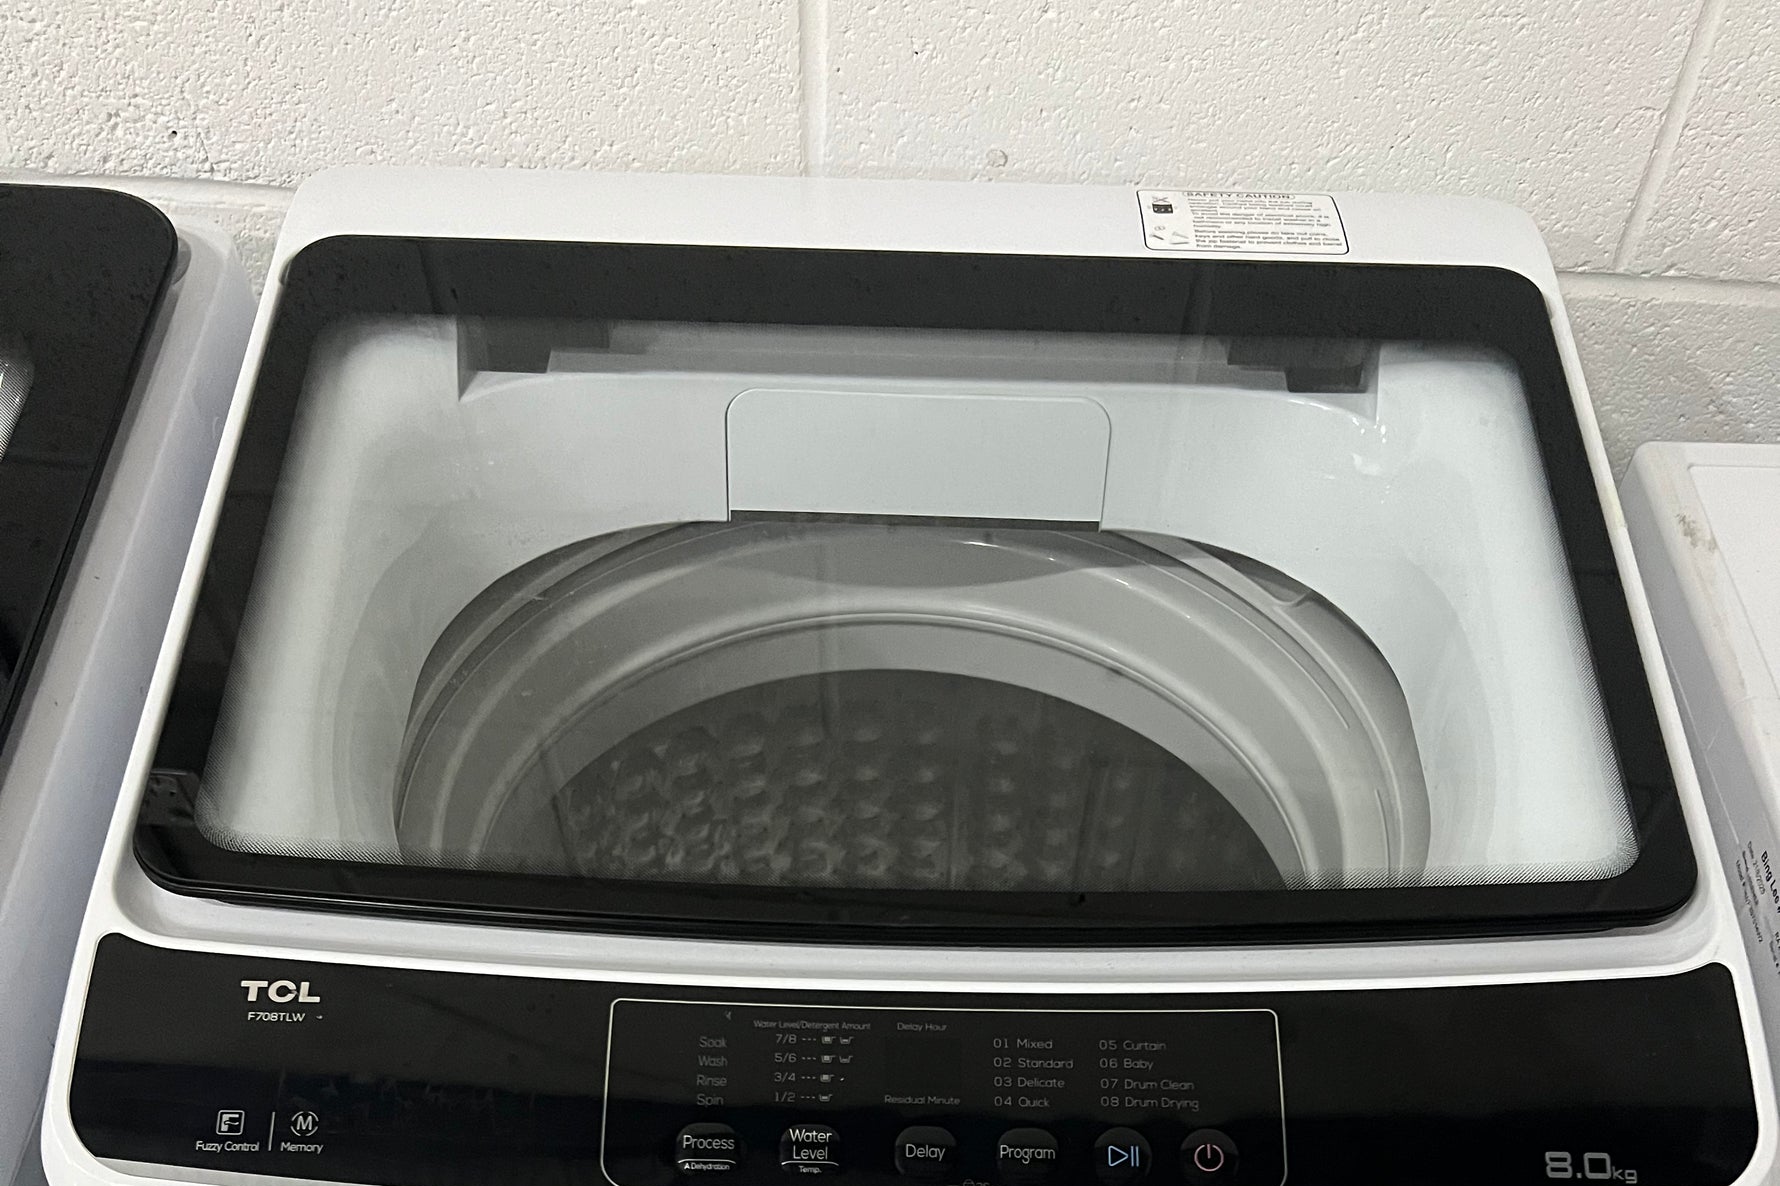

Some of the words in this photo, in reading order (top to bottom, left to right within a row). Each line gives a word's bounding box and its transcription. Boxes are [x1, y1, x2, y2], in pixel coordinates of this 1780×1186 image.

[240, 980, 321, 1003] TCL
[247, 1011, 306, 1022] F708TLW
[753, 1020, 777, 1028] Water
[841, 1021, 871, 1030] Amount
[897, 1022, 923, 1032] Delay
[699, 1037, 728, 1048] Soak
[775, 1033, 797, 1044] 7/8
[993, 1038, 1009, 1049] 01
[1016, 1039, 1053, 1049] Mixed
[1099, 1039, 1118, 1051] 05
[1123, 1040, 1166, 1051] Curtain
[697, 1055, 728, 1067] Wash
[774, 1052, 797, 1063] 5/6
[993, 1057, 1012, 1068] 02
[1017, 1057, 1074, 1069] Standard
[1099, 1058, 1118, 1069] 06
[1123, 1058, 1154, 1072] Baby
[696, 1074, 728, 1087] Rinse
[773, 1072, 796, 1083] 3/4
[993, 1077, 1013, 1088] 03
[1017, 1077, 1065, 1089] Delicate
[1100, 1078, 1119, 1089] 07
[1124, 1079, 1157, 1090] Drum
[1159, 1079, 1195, 1091] Clean
[696, 1093, 724, 1108] Spin
[774, 1092, 796, 1102] 1/2
[884, 1095, 926, 1105] Residual
[927, 1095, 960, 1105] Minute
[993, 1096, 1013, 1107] 04
[1018, 1096, 1050, 1109] Quick
[1100, 1096, 1120, 1108] 08
[1125, 1097, 1159, 1109] Drum
[1161, 1097, 1199, 1113] Drying
[788, 1128, 833, 1143] Water
[195, 1140, 223, 1153] Fuzzy
[224, 1141, 260, 1152] Control
[280, 1142, 324, 1154] Memory
[682, 1134, 735, 1150] Process
[793, 1144, 828, 1160] Level
[905, 1143, 946, 1162] Delay
[1000, 1144, 1056, 1164] Program
[798, 1165, 823, 1174] Temp.
